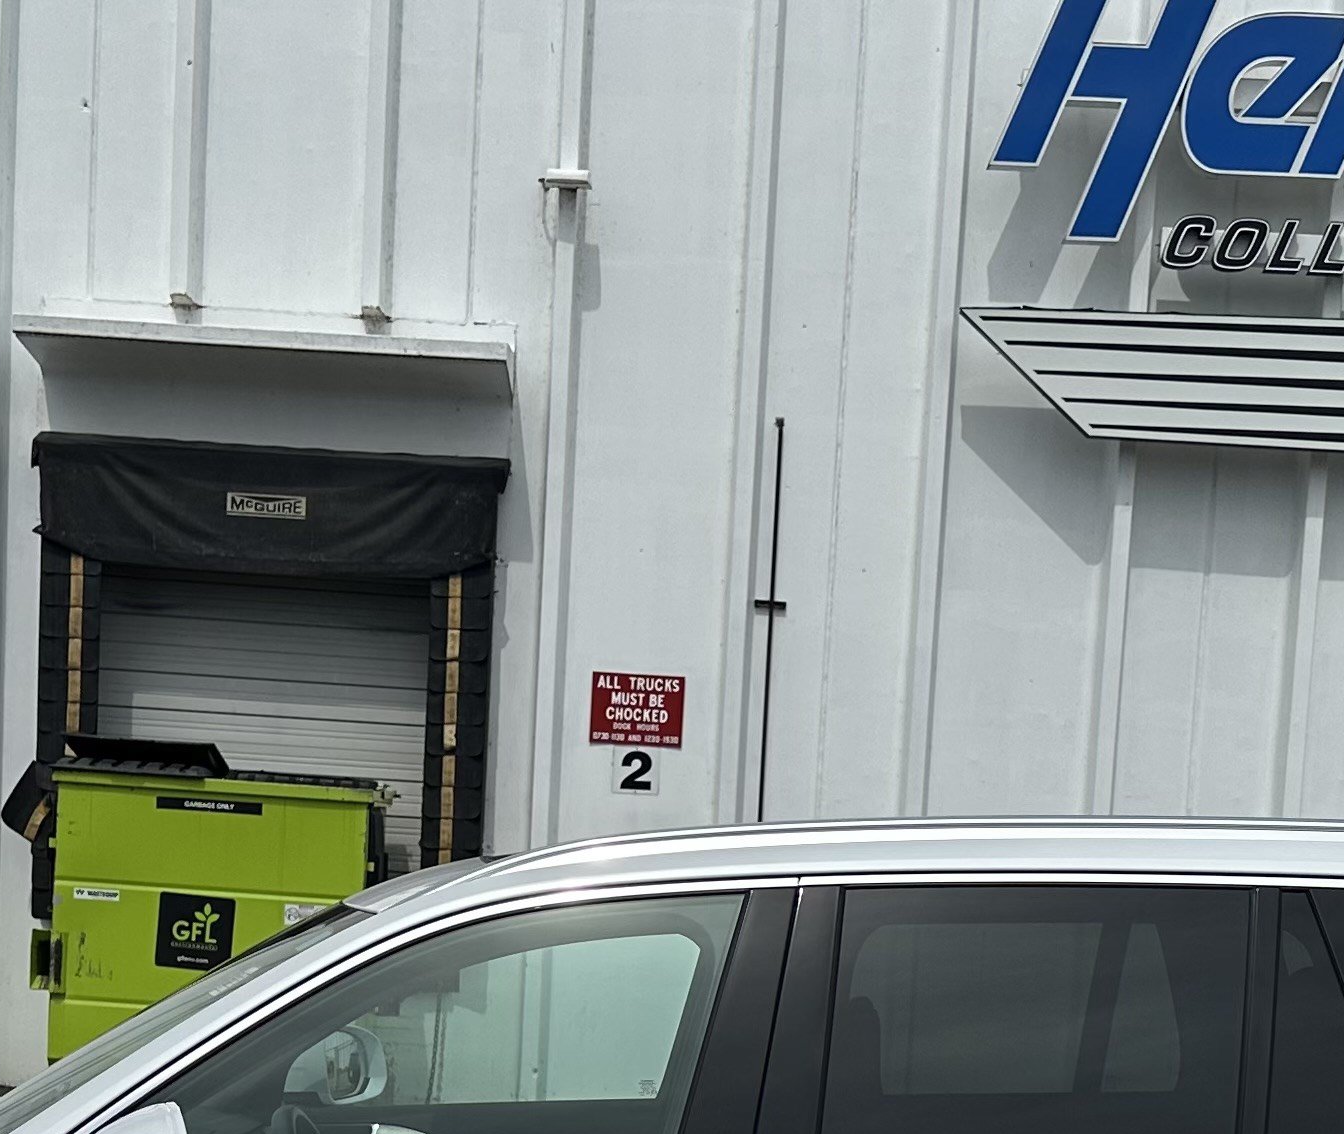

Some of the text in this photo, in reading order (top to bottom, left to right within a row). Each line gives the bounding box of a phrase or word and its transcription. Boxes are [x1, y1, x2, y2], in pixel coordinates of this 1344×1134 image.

[597, 675, 680, 692] ALL TRUCKS
[611, 691, 665, 708] MUST BE
[605, 706, 669, 724] CHOCKED
[620, 750, 652, 790] 2
[171, 903, 220, 944] GFL
